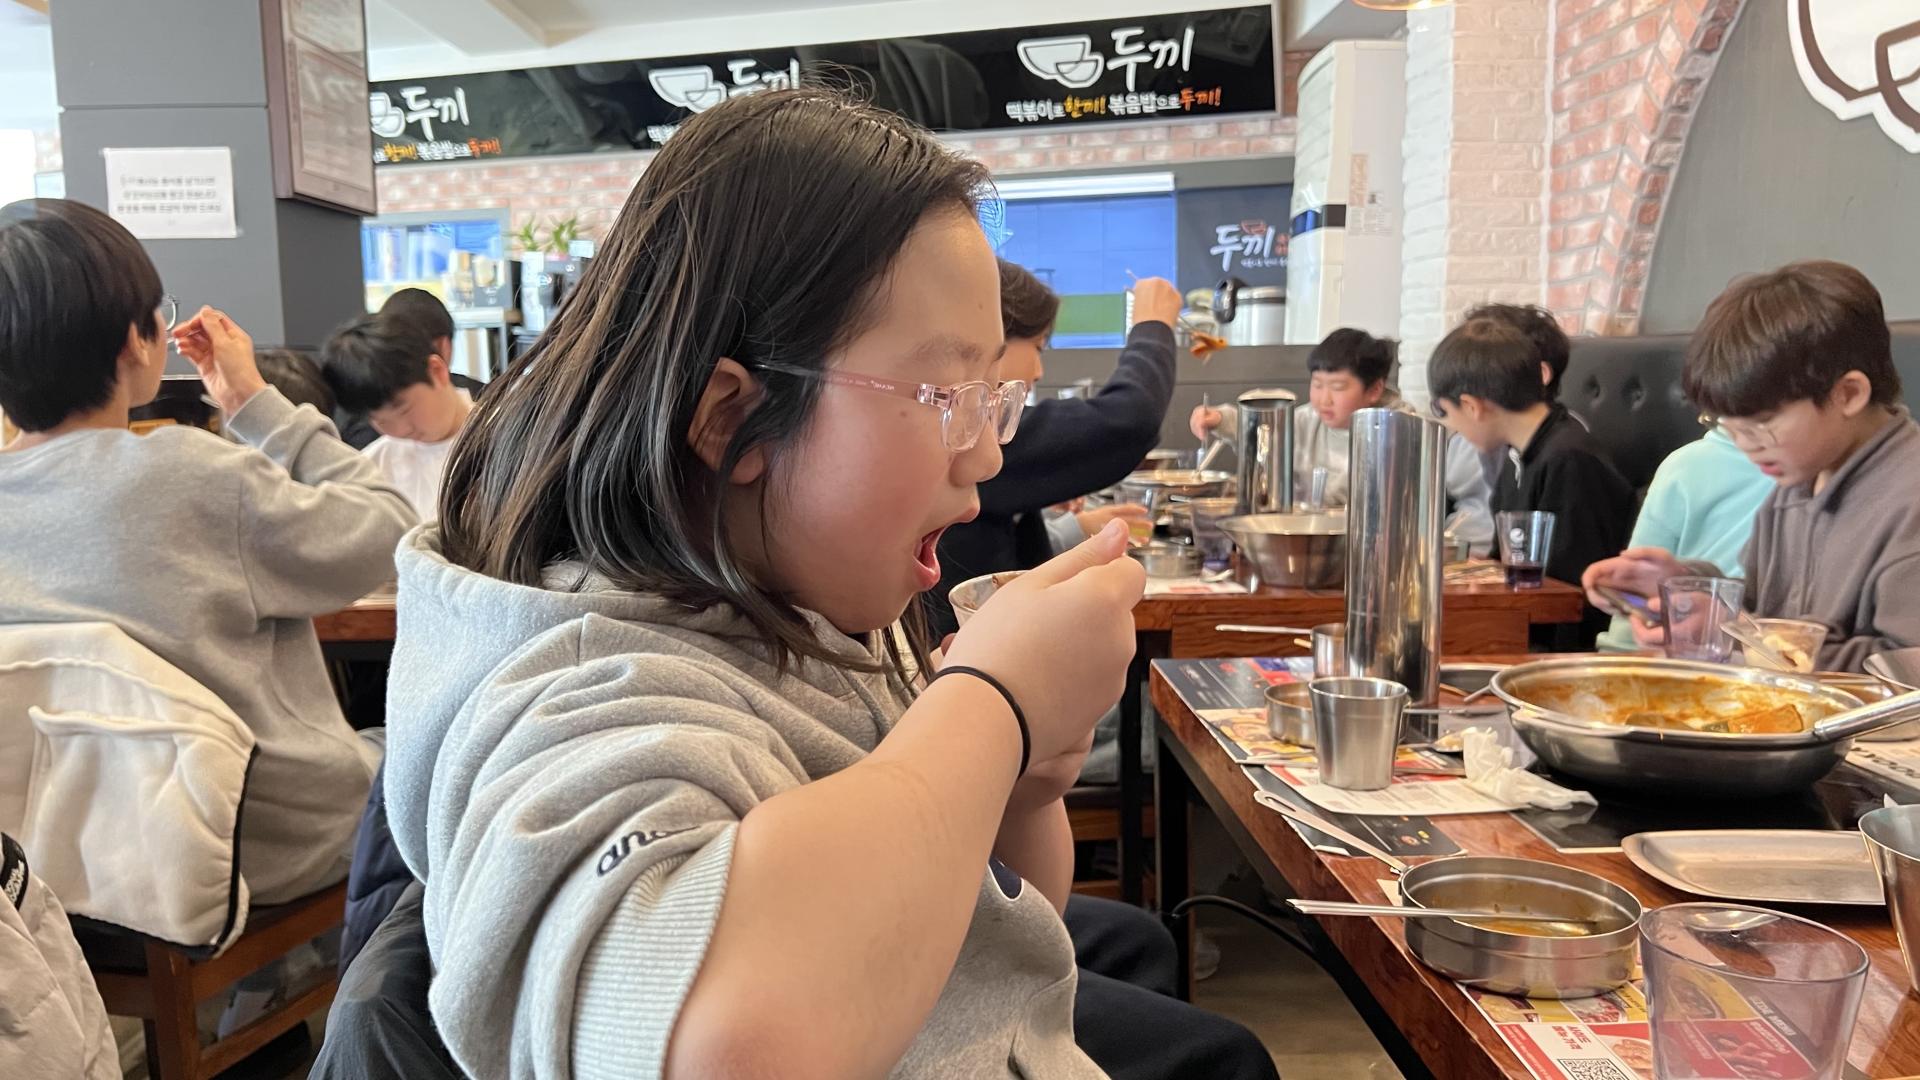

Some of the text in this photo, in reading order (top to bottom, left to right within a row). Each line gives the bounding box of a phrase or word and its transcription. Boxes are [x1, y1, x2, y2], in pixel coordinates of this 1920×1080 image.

[1106, 24, 1195, 92] 두끼
[400, 85, 470, 142] 두끼
[1209, 223, 1276, 273] 두끼
